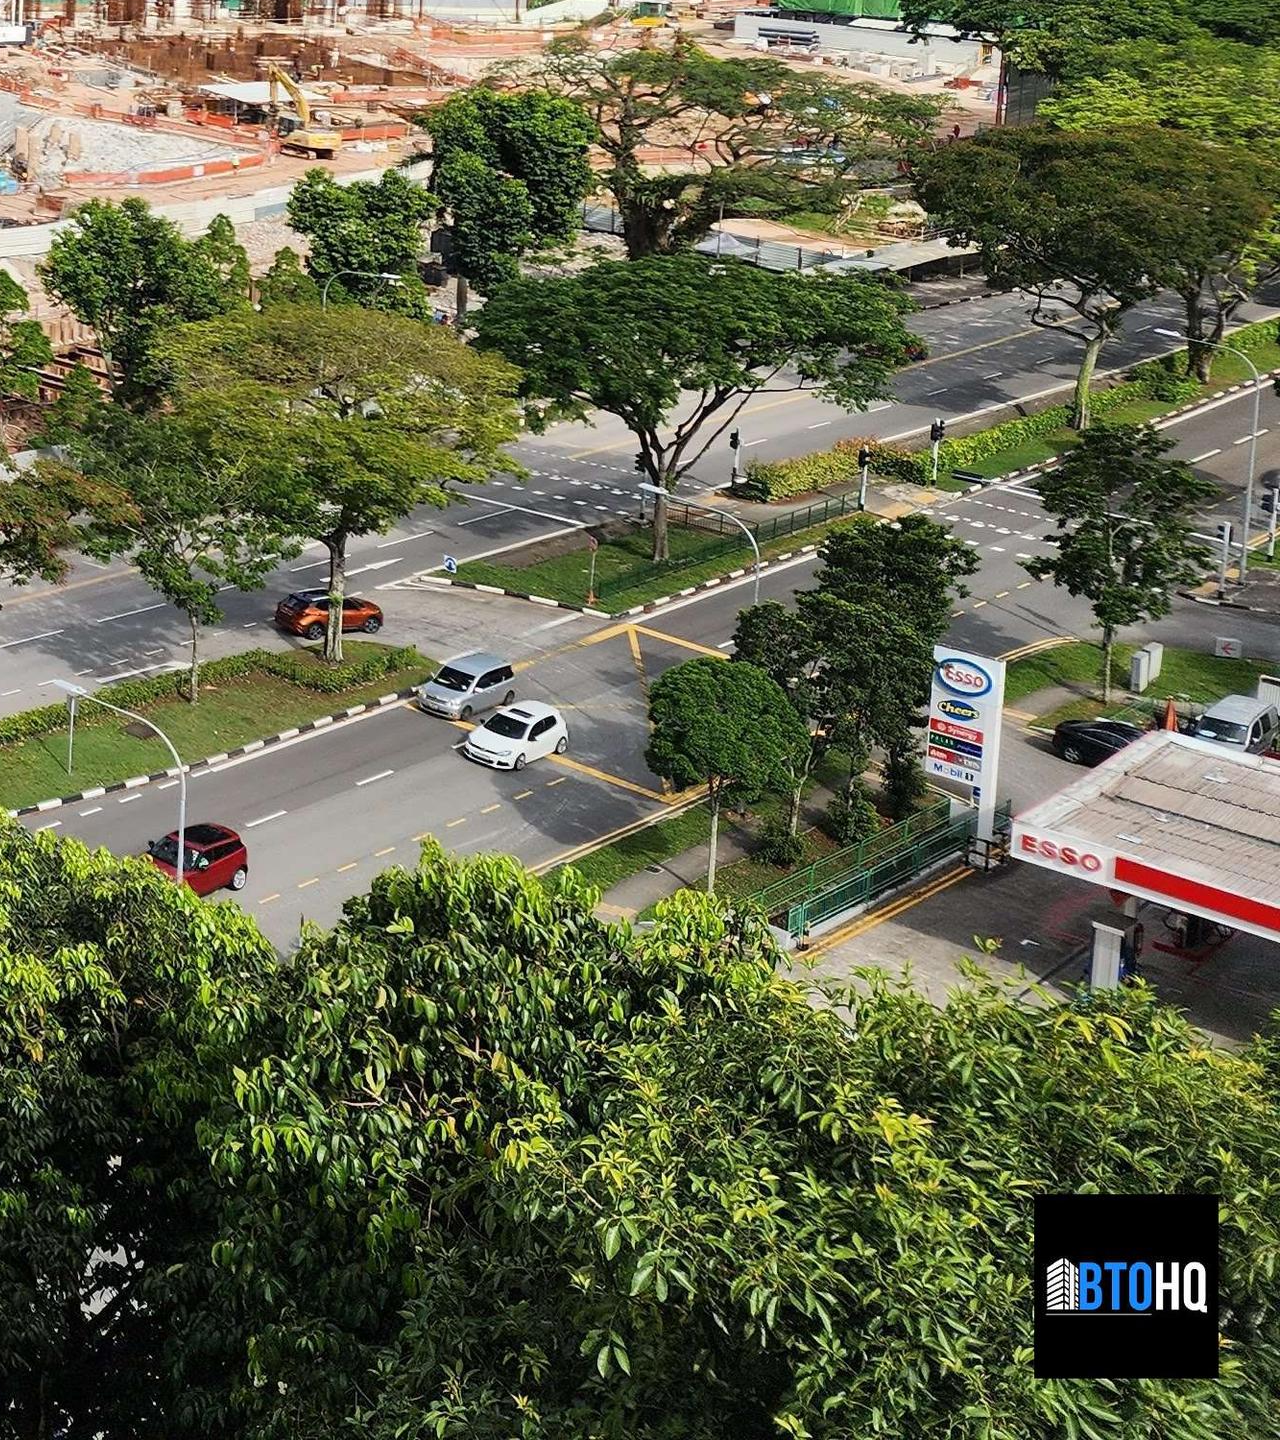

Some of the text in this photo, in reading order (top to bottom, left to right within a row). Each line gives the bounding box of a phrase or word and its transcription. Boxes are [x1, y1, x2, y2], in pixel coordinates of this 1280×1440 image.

[938, 700, 980, 719] Cheers
[947, 725, 978, 741] Synergy
[933, 762, 963, 779] Mobil
